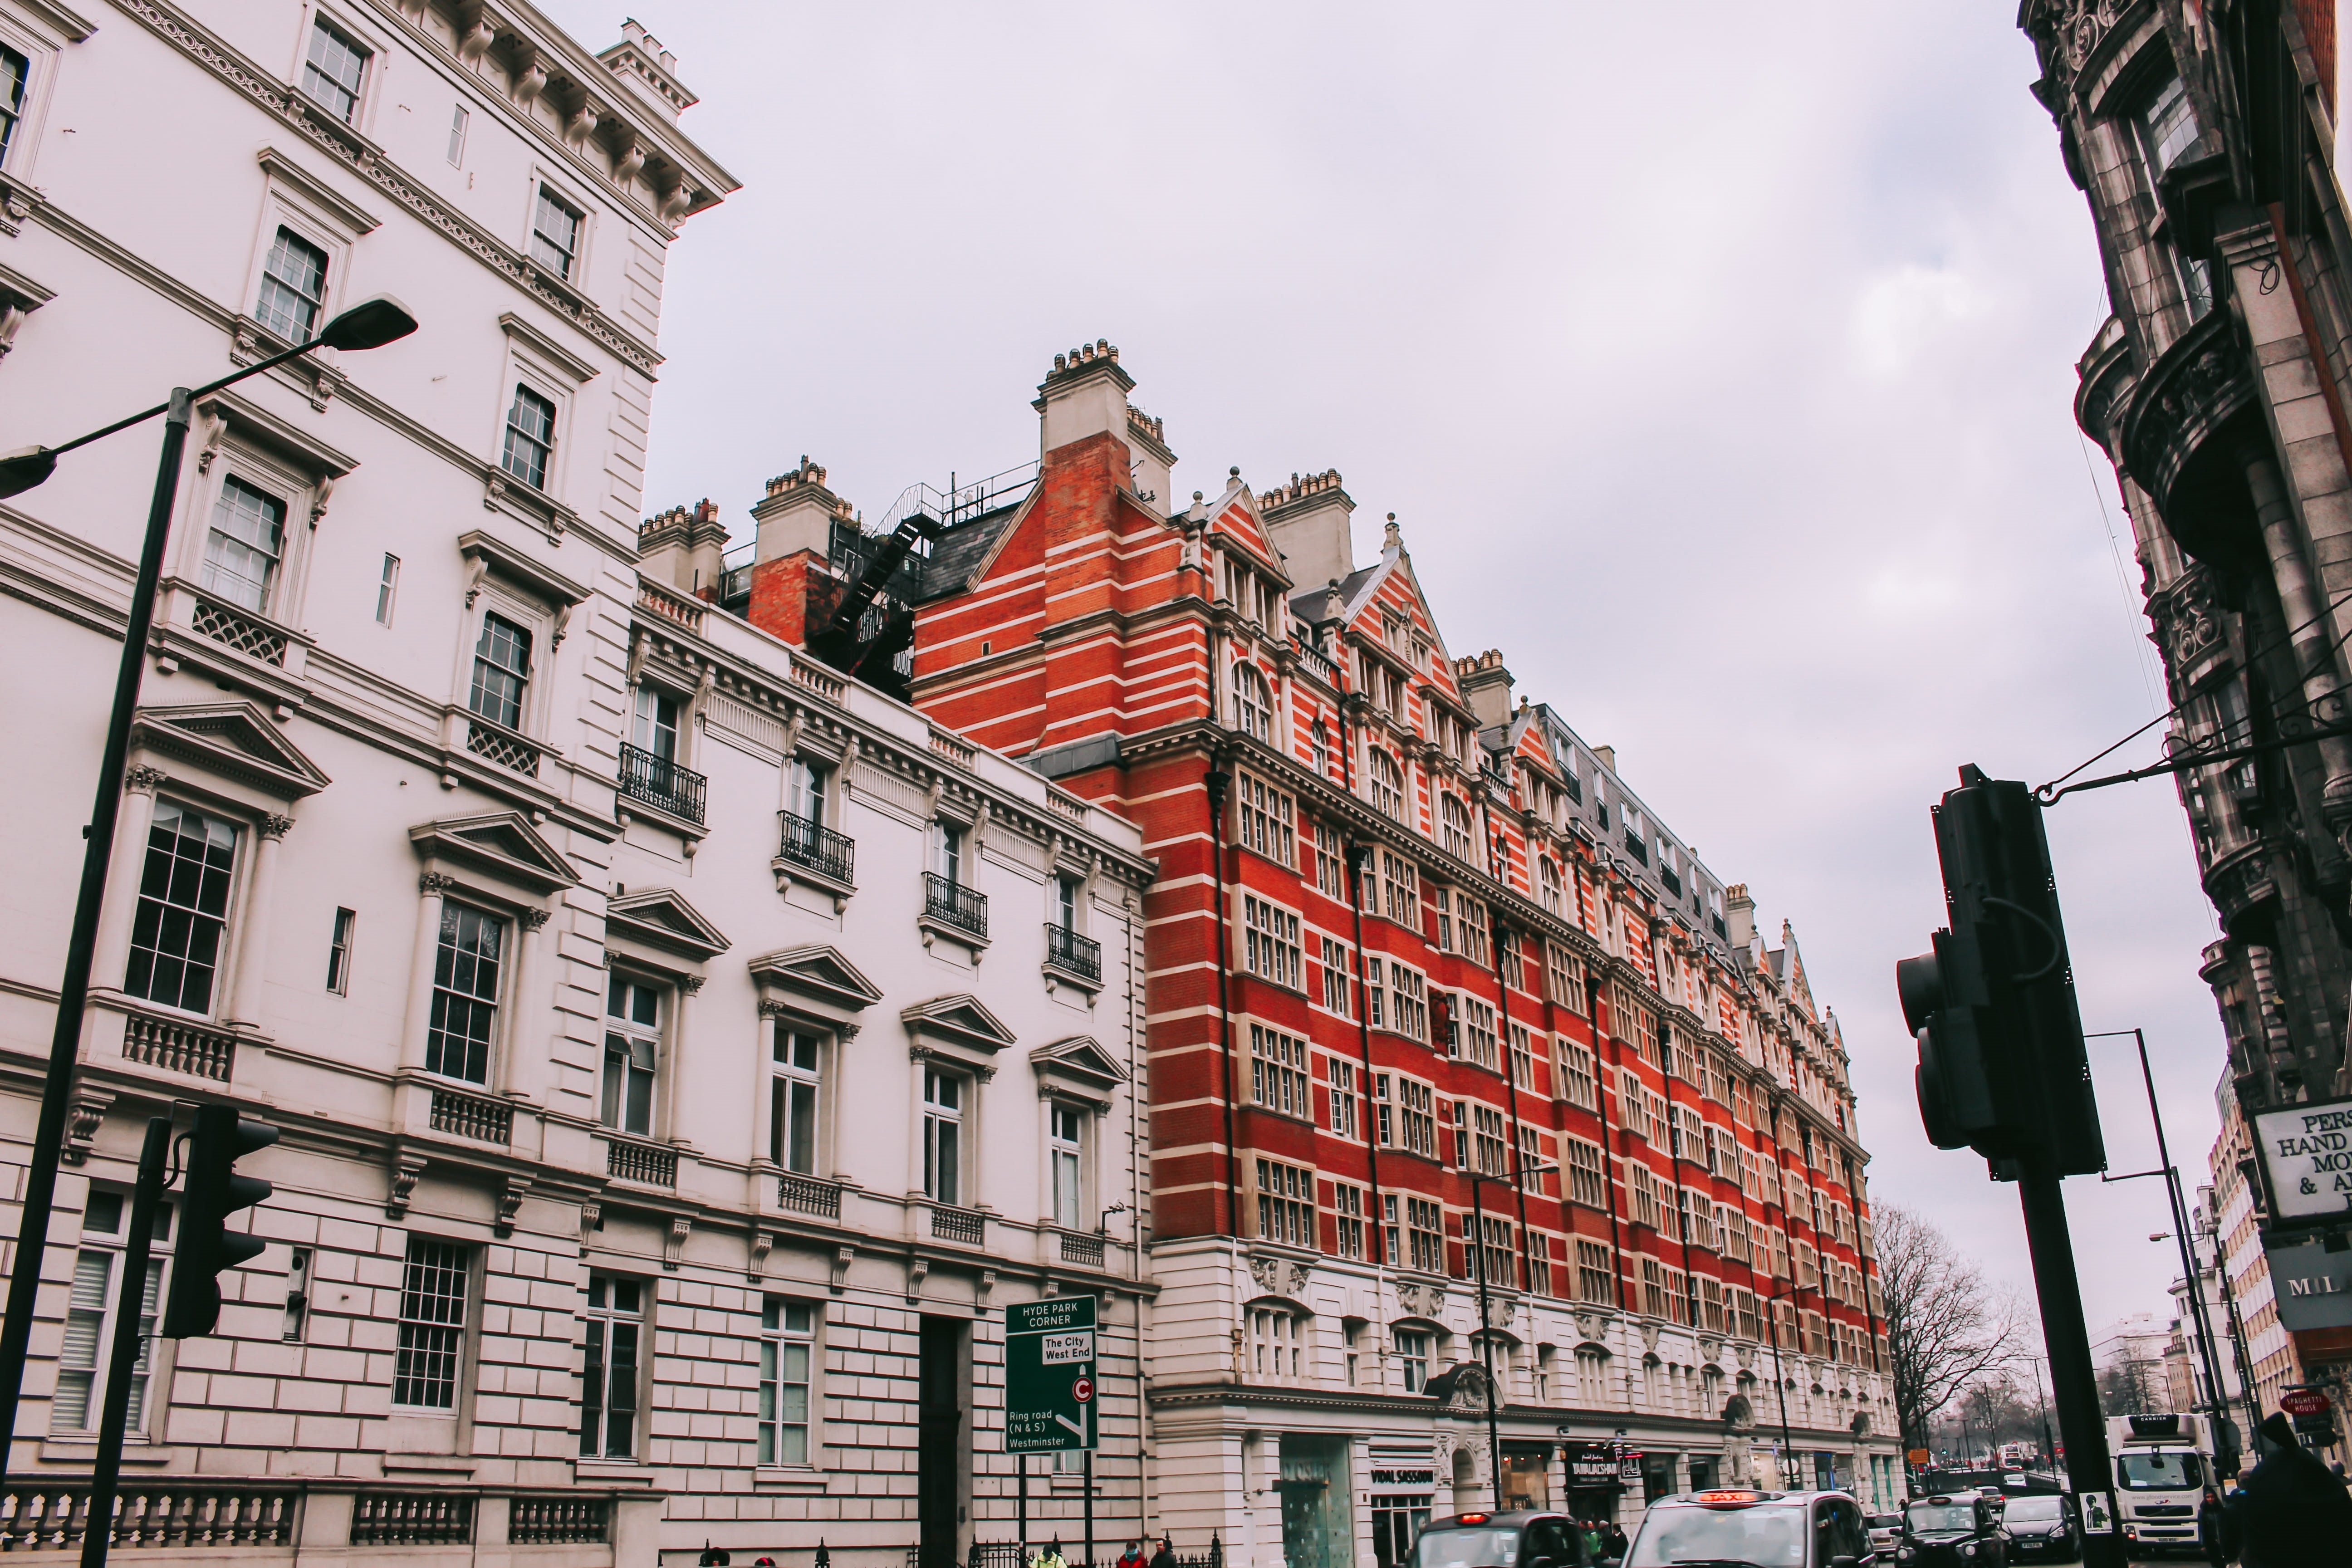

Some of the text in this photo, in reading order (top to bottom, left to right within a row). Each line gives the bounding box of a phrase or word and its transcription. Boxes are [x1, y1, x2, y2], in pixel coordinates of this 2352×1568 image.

[2277, 1132, 2347, 1157] HAND
[2300, 1177, 2317, 1195] &
[1023, 1303, 1078, 1316] HYDE PARK
[1029, 1315, 1070, 1327] CORNER
[1046, 1337, 1084, 1348] The City
[1046, 1348, 1090, 1359] West End
[2287, 1396, 2322, 1405] SPAGHETTI
[1010, 1409, 1052, 1421] Ring road
[1009, 1421, 1045, 1434] (N & S)
[1009, 1437, 1065, 1448] Westminster
[1371, 1470, 1433, 1484] VIDAL SASSOON
